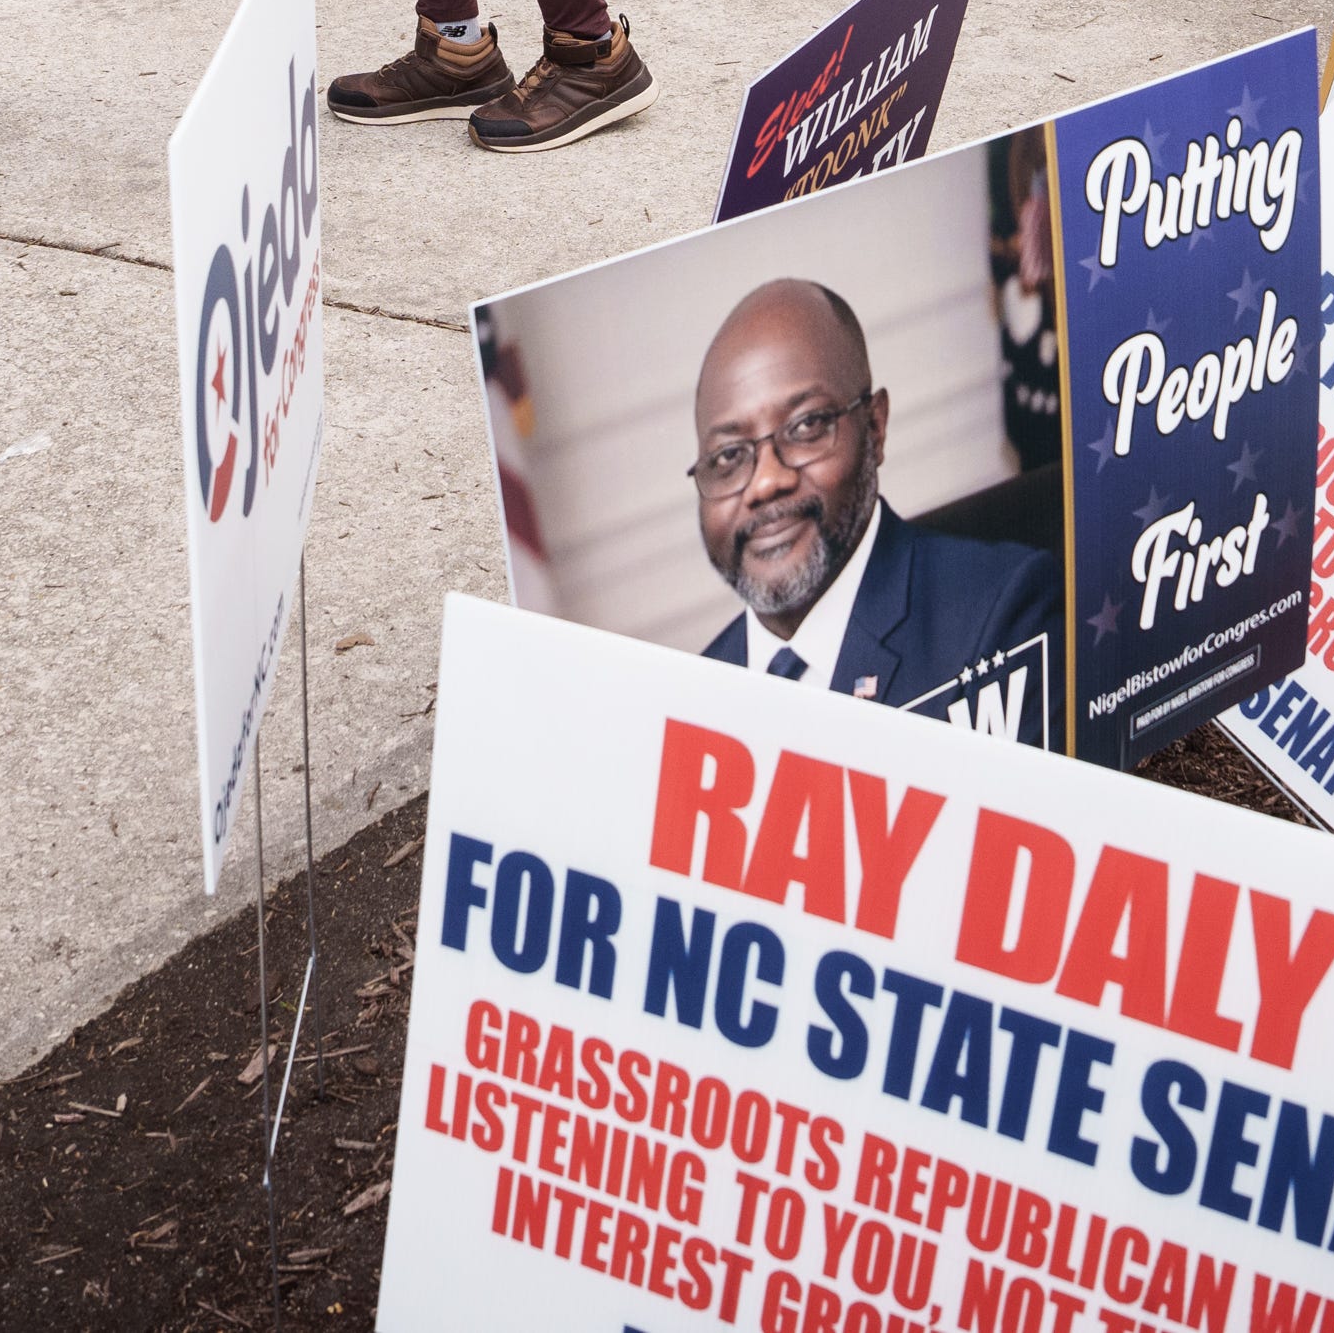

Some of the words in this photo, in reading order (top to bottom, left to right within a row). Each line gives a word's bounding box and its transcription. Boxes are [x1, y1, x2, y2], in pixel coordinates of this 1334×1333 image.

[784, 4, 939, 177] WILLIAM
[196, 54, 318, 523] Ojeda
[1085, 117, 1304, 268] Putting
[1102, 289, 1299, 458] People
[1131, 493, 1269, 630] First
[649, 716, 948, 942] RAY
[441, 832, 621, 998] FOR
[644, 896, 786, 1049] NC
[806, 948, 1117, 1168] STATE
[424, 1063, 706, 1226] LISTENING
[736, 1170, 806, 1261] TO
[822, 1203, 942, 1324] YOU,
[465, 999, 845, 1192] GRASSROOTS
[854, 1132, 1236, 1331] REPUBLICAN
[491, 1165, 754, 1324] INTEREST
